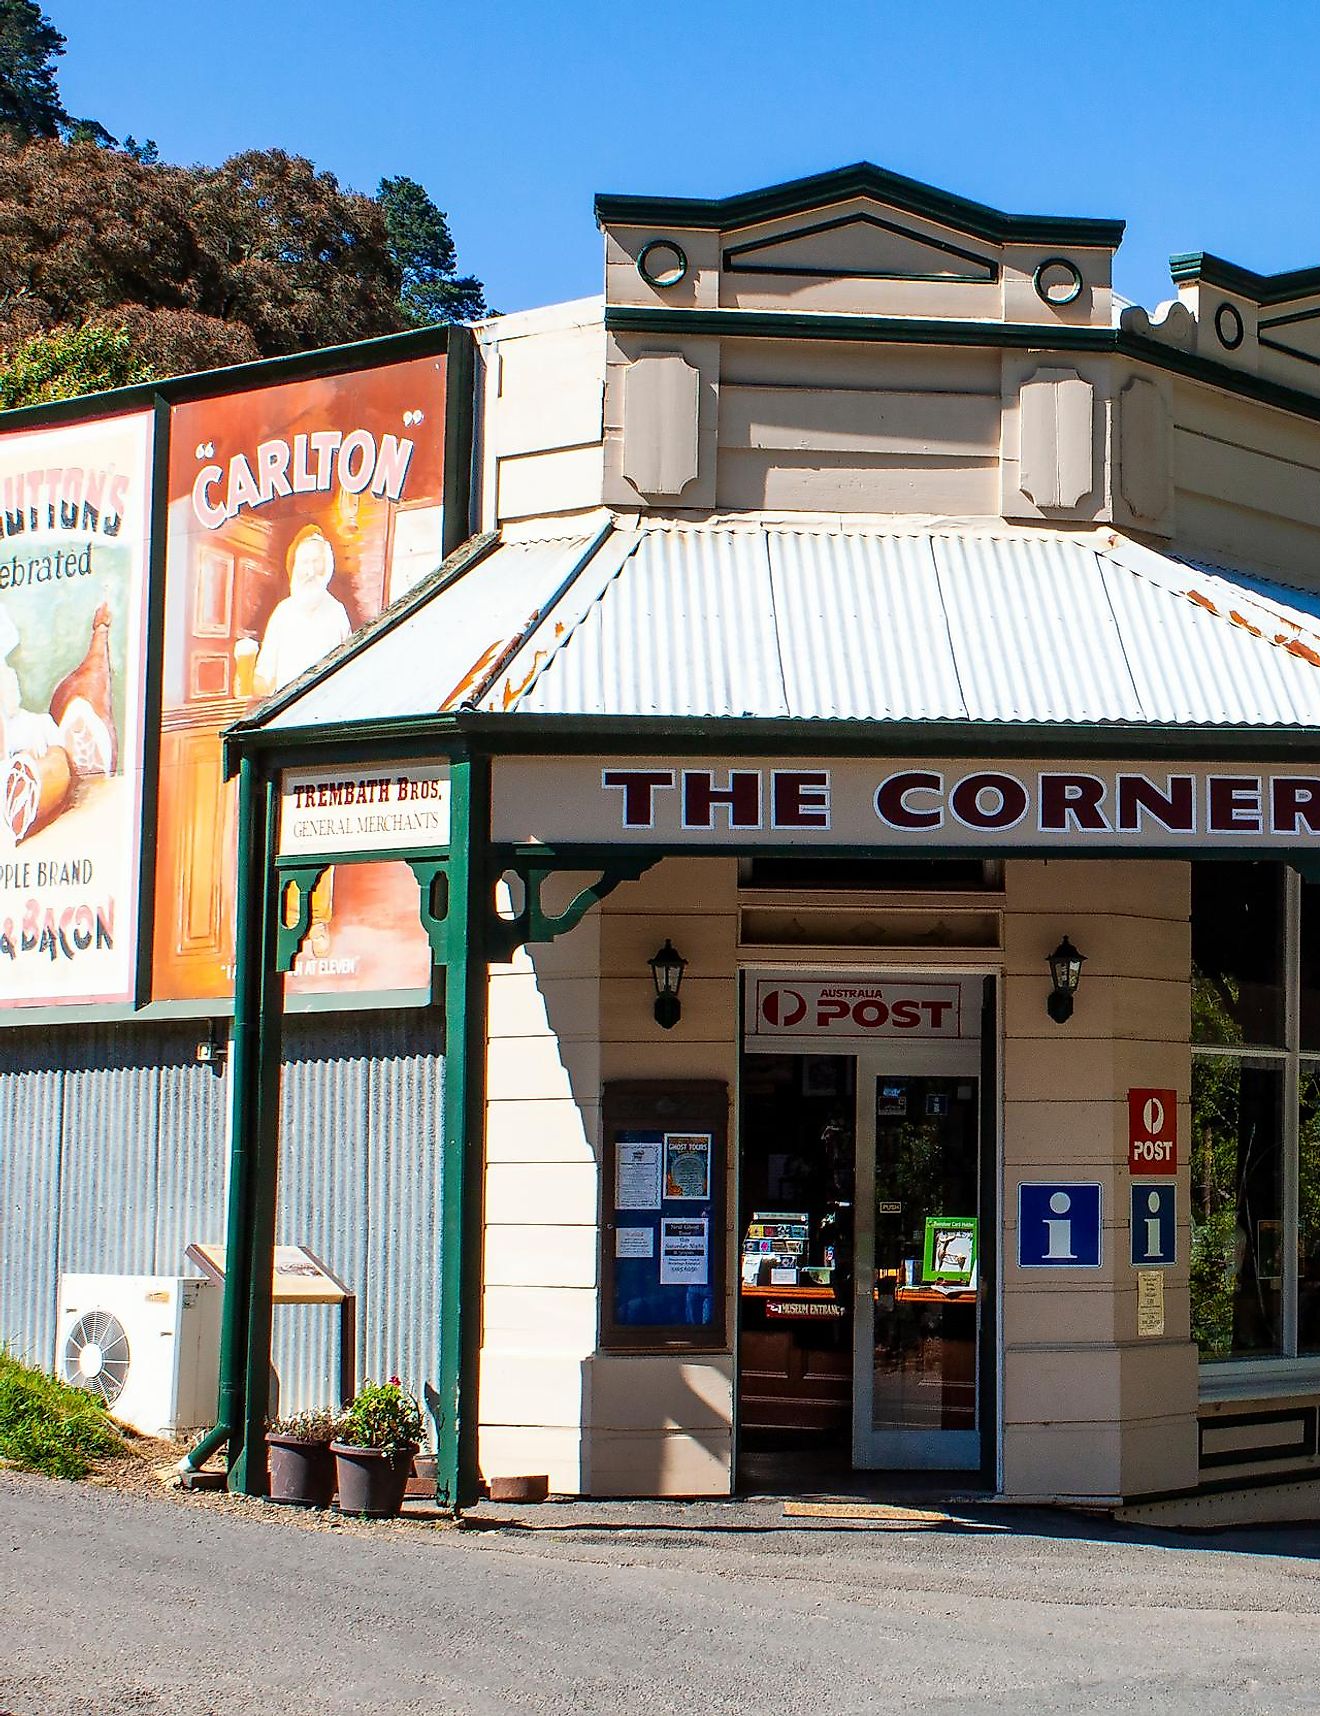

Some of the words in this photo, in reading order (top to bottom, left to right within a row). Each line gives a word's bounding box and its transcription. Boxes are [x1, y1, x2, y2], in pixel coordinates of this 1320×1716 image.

[0, 463, 130, 537] UTTON'S
[293, 777, 392, 809] TREMBATH
[601, 768, 832, 830] THE
[293, 817, 353, 839] GENERAL
[356, 811, 439, 834] MERCHANTS
[37, 858, 93, 888] BRAND
[21, 896, 115, 962] BACON
[820, 989, 883, 999] AUSTRALIA
[816, 999, 953, 1029] POST
[1134, 1142, 1173, 1161] POST
[782, 1302, 809, 1315] MUSEUM
